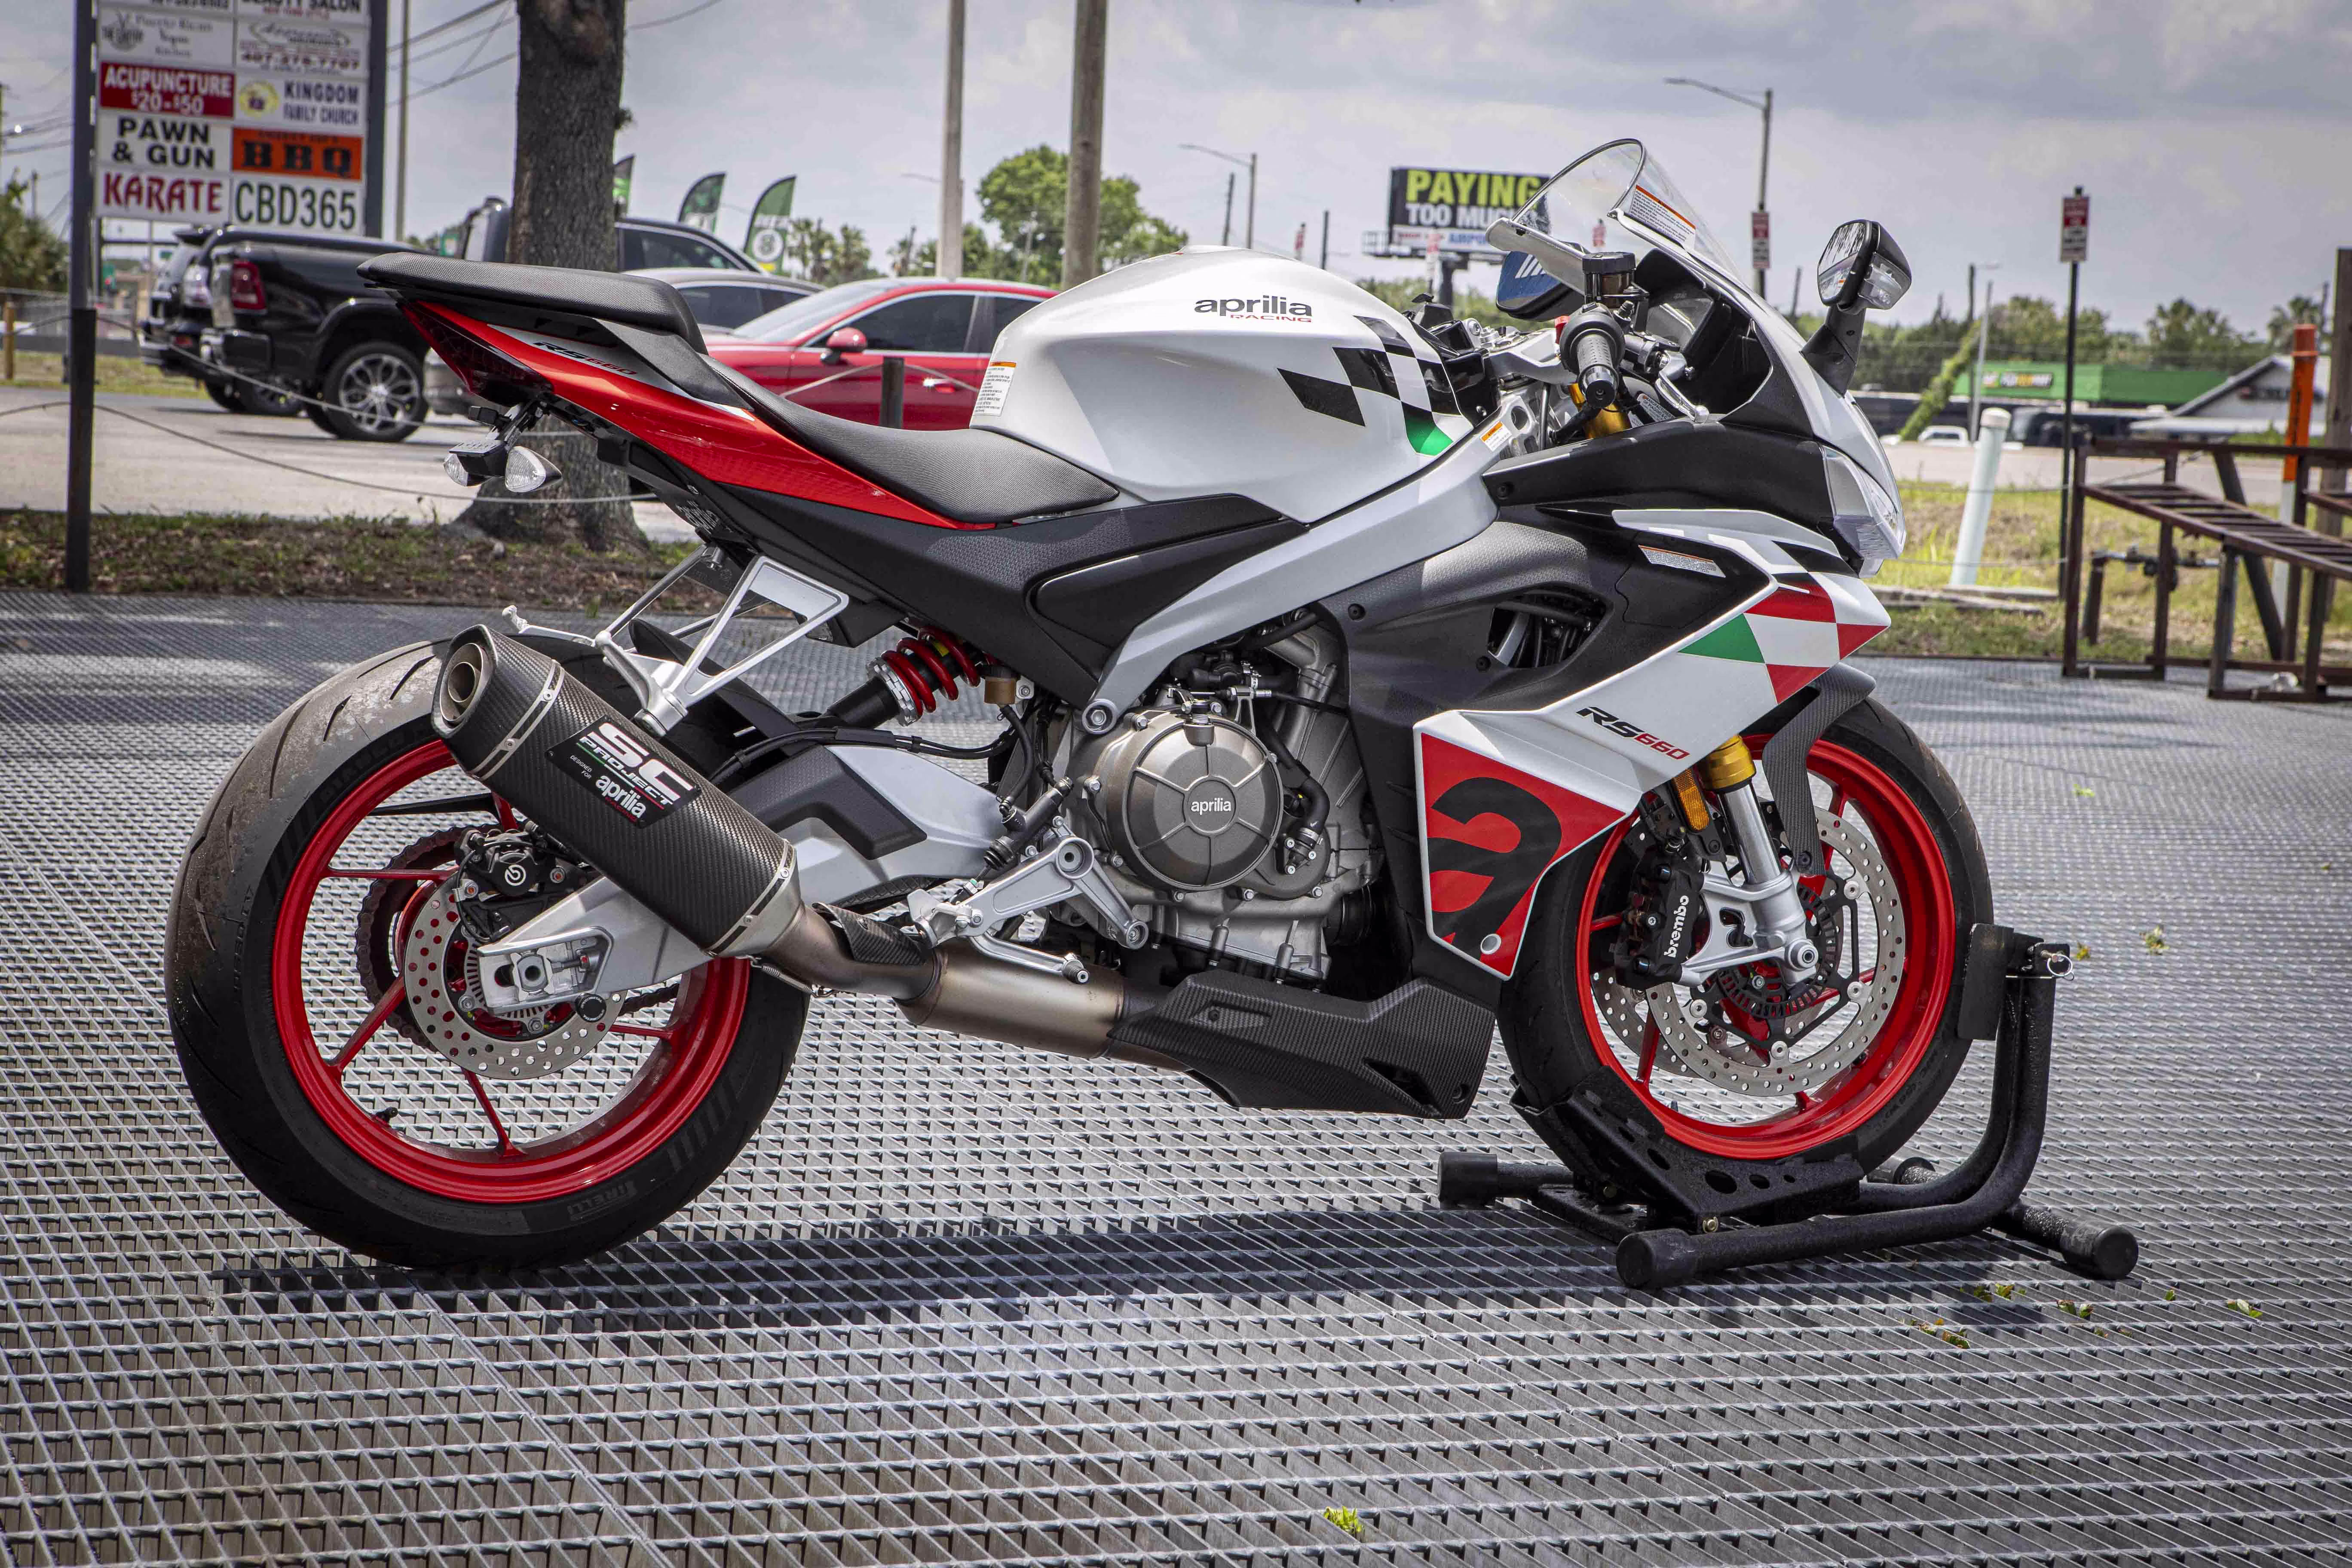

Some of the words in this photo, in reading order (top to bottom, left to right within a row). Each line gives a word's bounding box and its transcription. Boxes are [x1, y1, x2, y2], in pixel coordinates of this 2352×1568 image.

[104, 66, 233, 98] ACUPUNCTURE
[284, 81, 359, 104] KINGDOM
[283, 103, 317, 123] FAMILY
[319, 106, 359, 125] CHURCH
[118, 117, 209, 144] PAWN
[113, 143, 132, 163] &
[147, 144, 214, 169] GUN
[243, 140, 352, 179] BBQ
[104, 173, 223, 214] KARATE
[1406, 169, 1541, 208] PAYING
[236, 181, 357, 231] CBD365
[1405, 202, 1452, 227] TOO
[1194, 294, 1312, 316] aprilia
[1231, 315, 1312, 323] RACING
[533, 342, 638, 375] RS660
[1576, 706, 1690, 760] RS660
[570, 754, 592, 773] DESIGNED
[579, 736, 673, 805] PROJECT
[581, 770, 592, 779] FOR
[587, 722, 694, 802] SC
[596, 775, 646, 818] aprilia
[1191, 797, 1231, 815] aprilia
[1663, 895, 1689, 958] brembo
